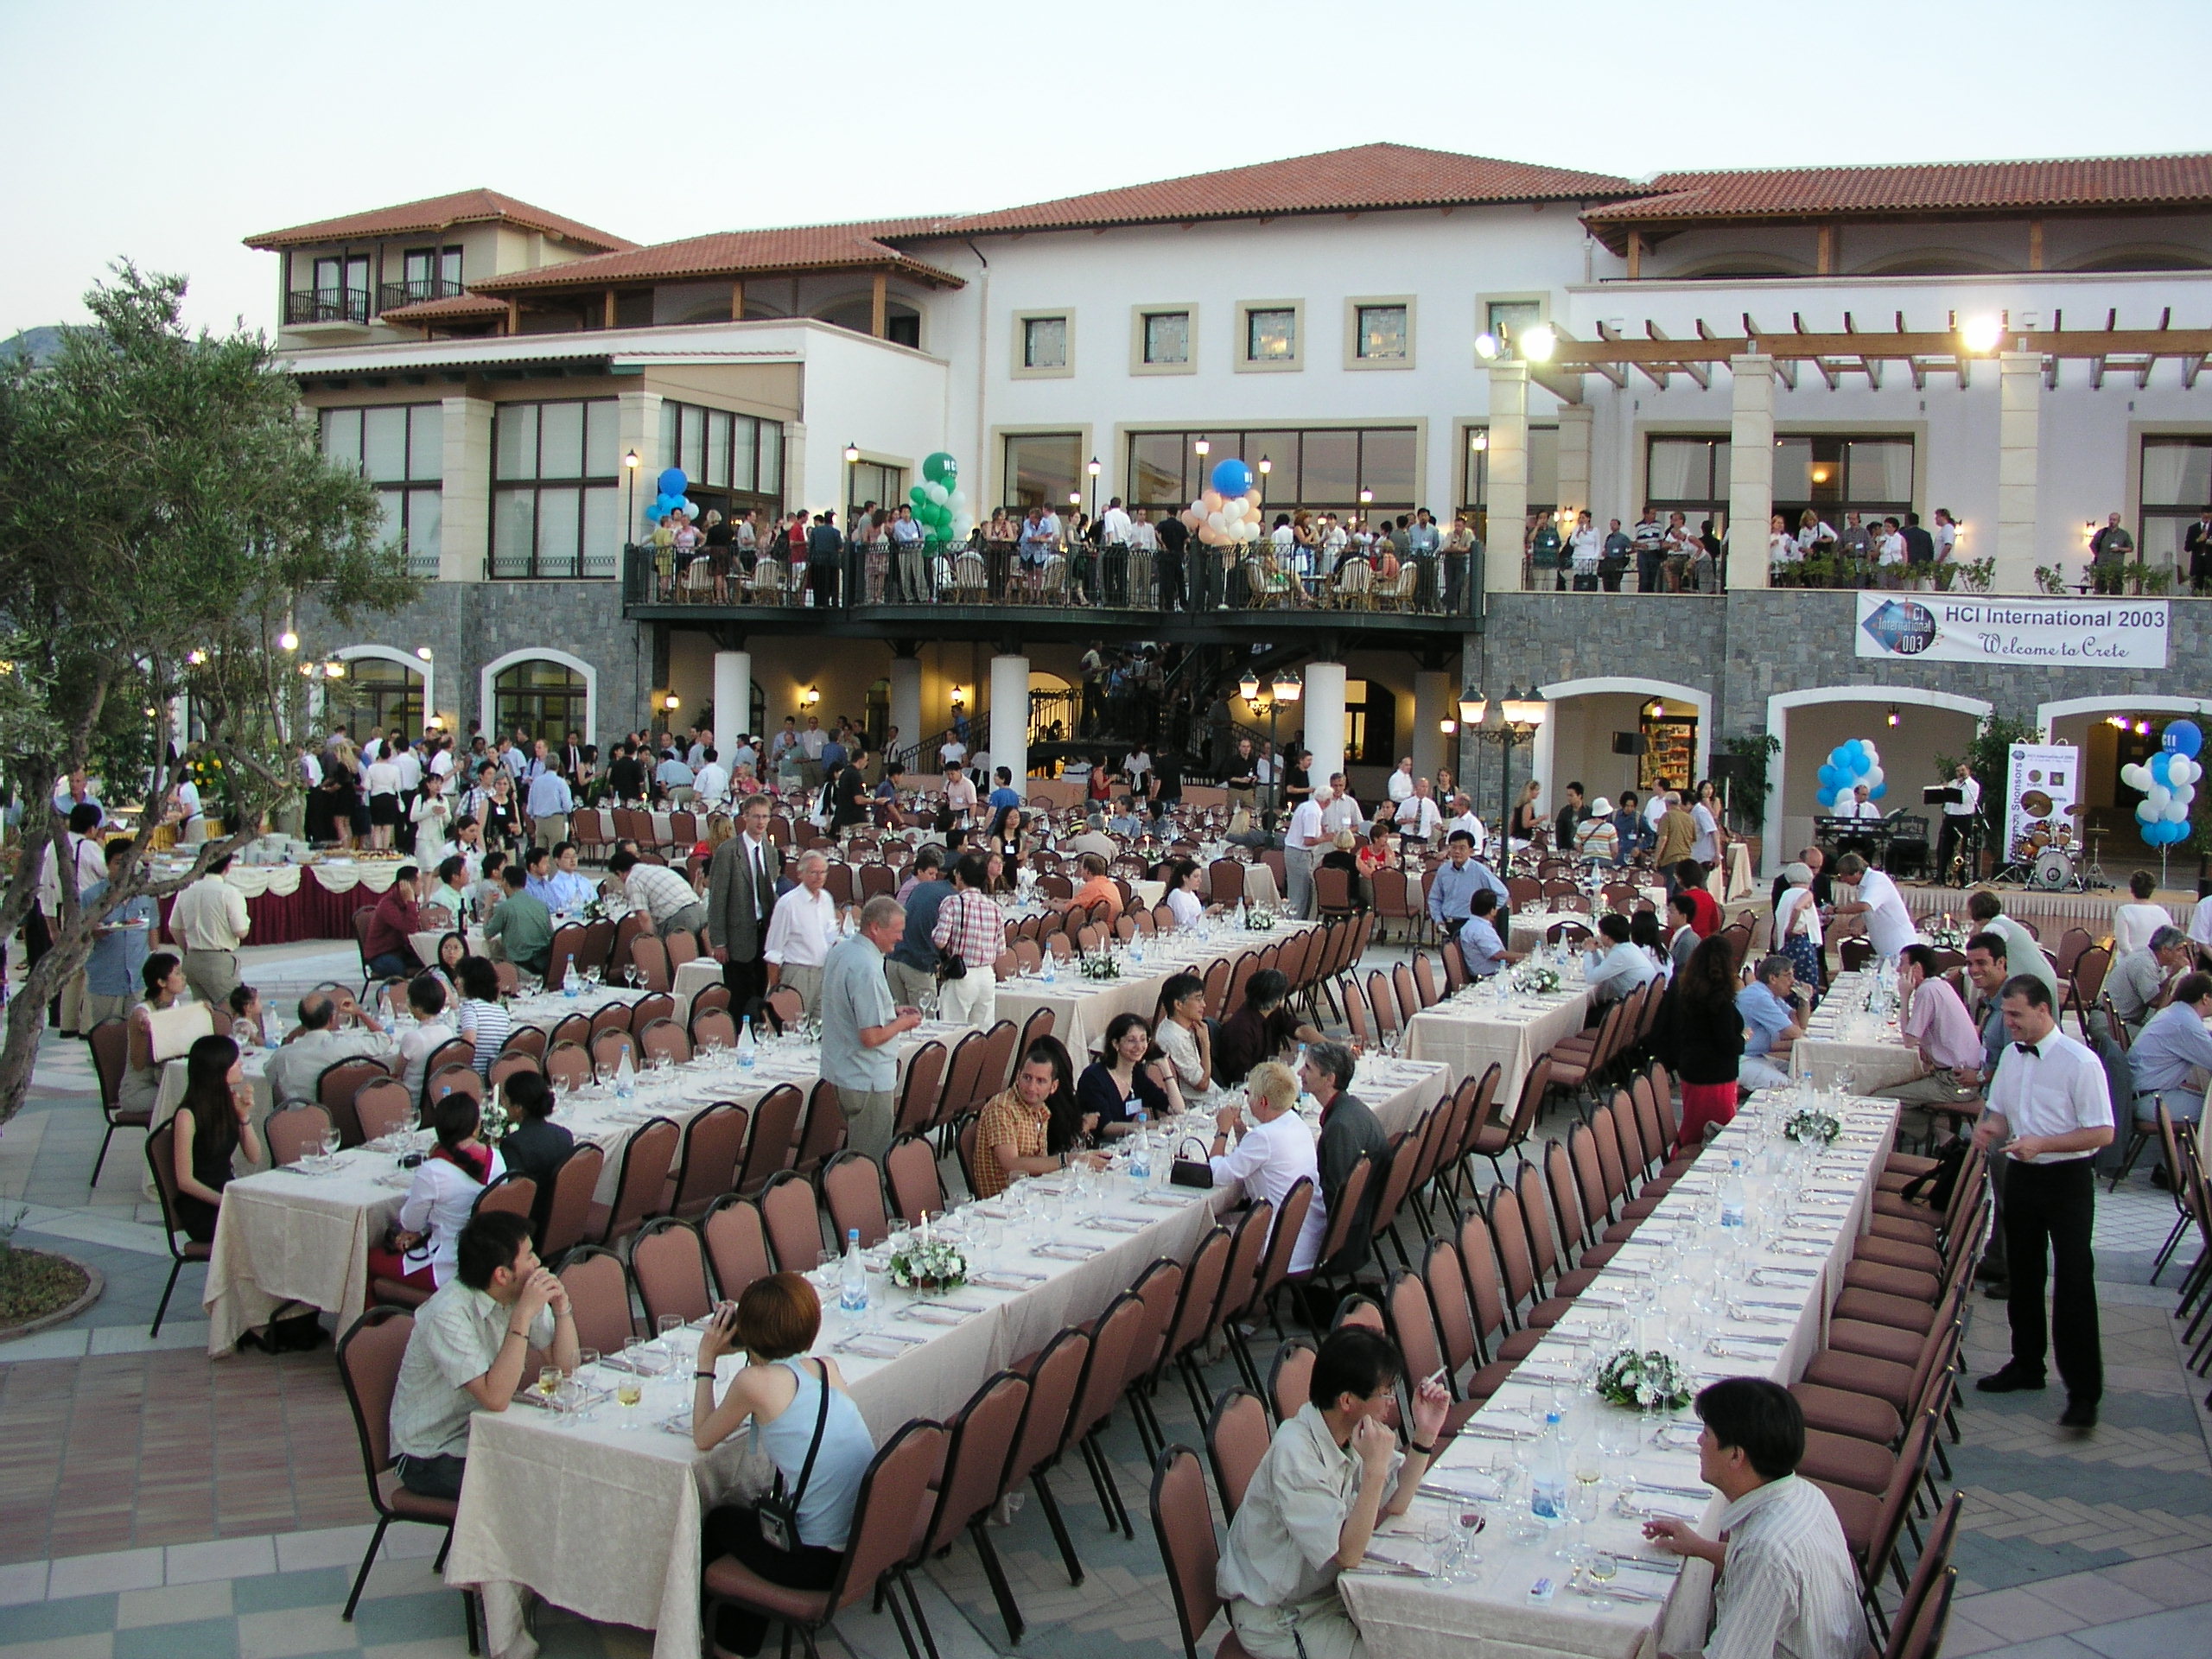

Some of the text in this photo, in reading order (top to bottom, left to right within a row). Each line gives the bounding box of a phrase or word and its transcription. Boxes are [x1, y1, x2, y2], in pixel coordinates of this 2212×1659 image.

[1878, 617, 1932, 632] International
[1946, 607, 2165, 628] HCI International 2003
[1895, 632, 1923, 653] 2003
[1978, 632, 2129, 658] Welcome to Crete
[2012, 762, 2022, 810] Sponsors
